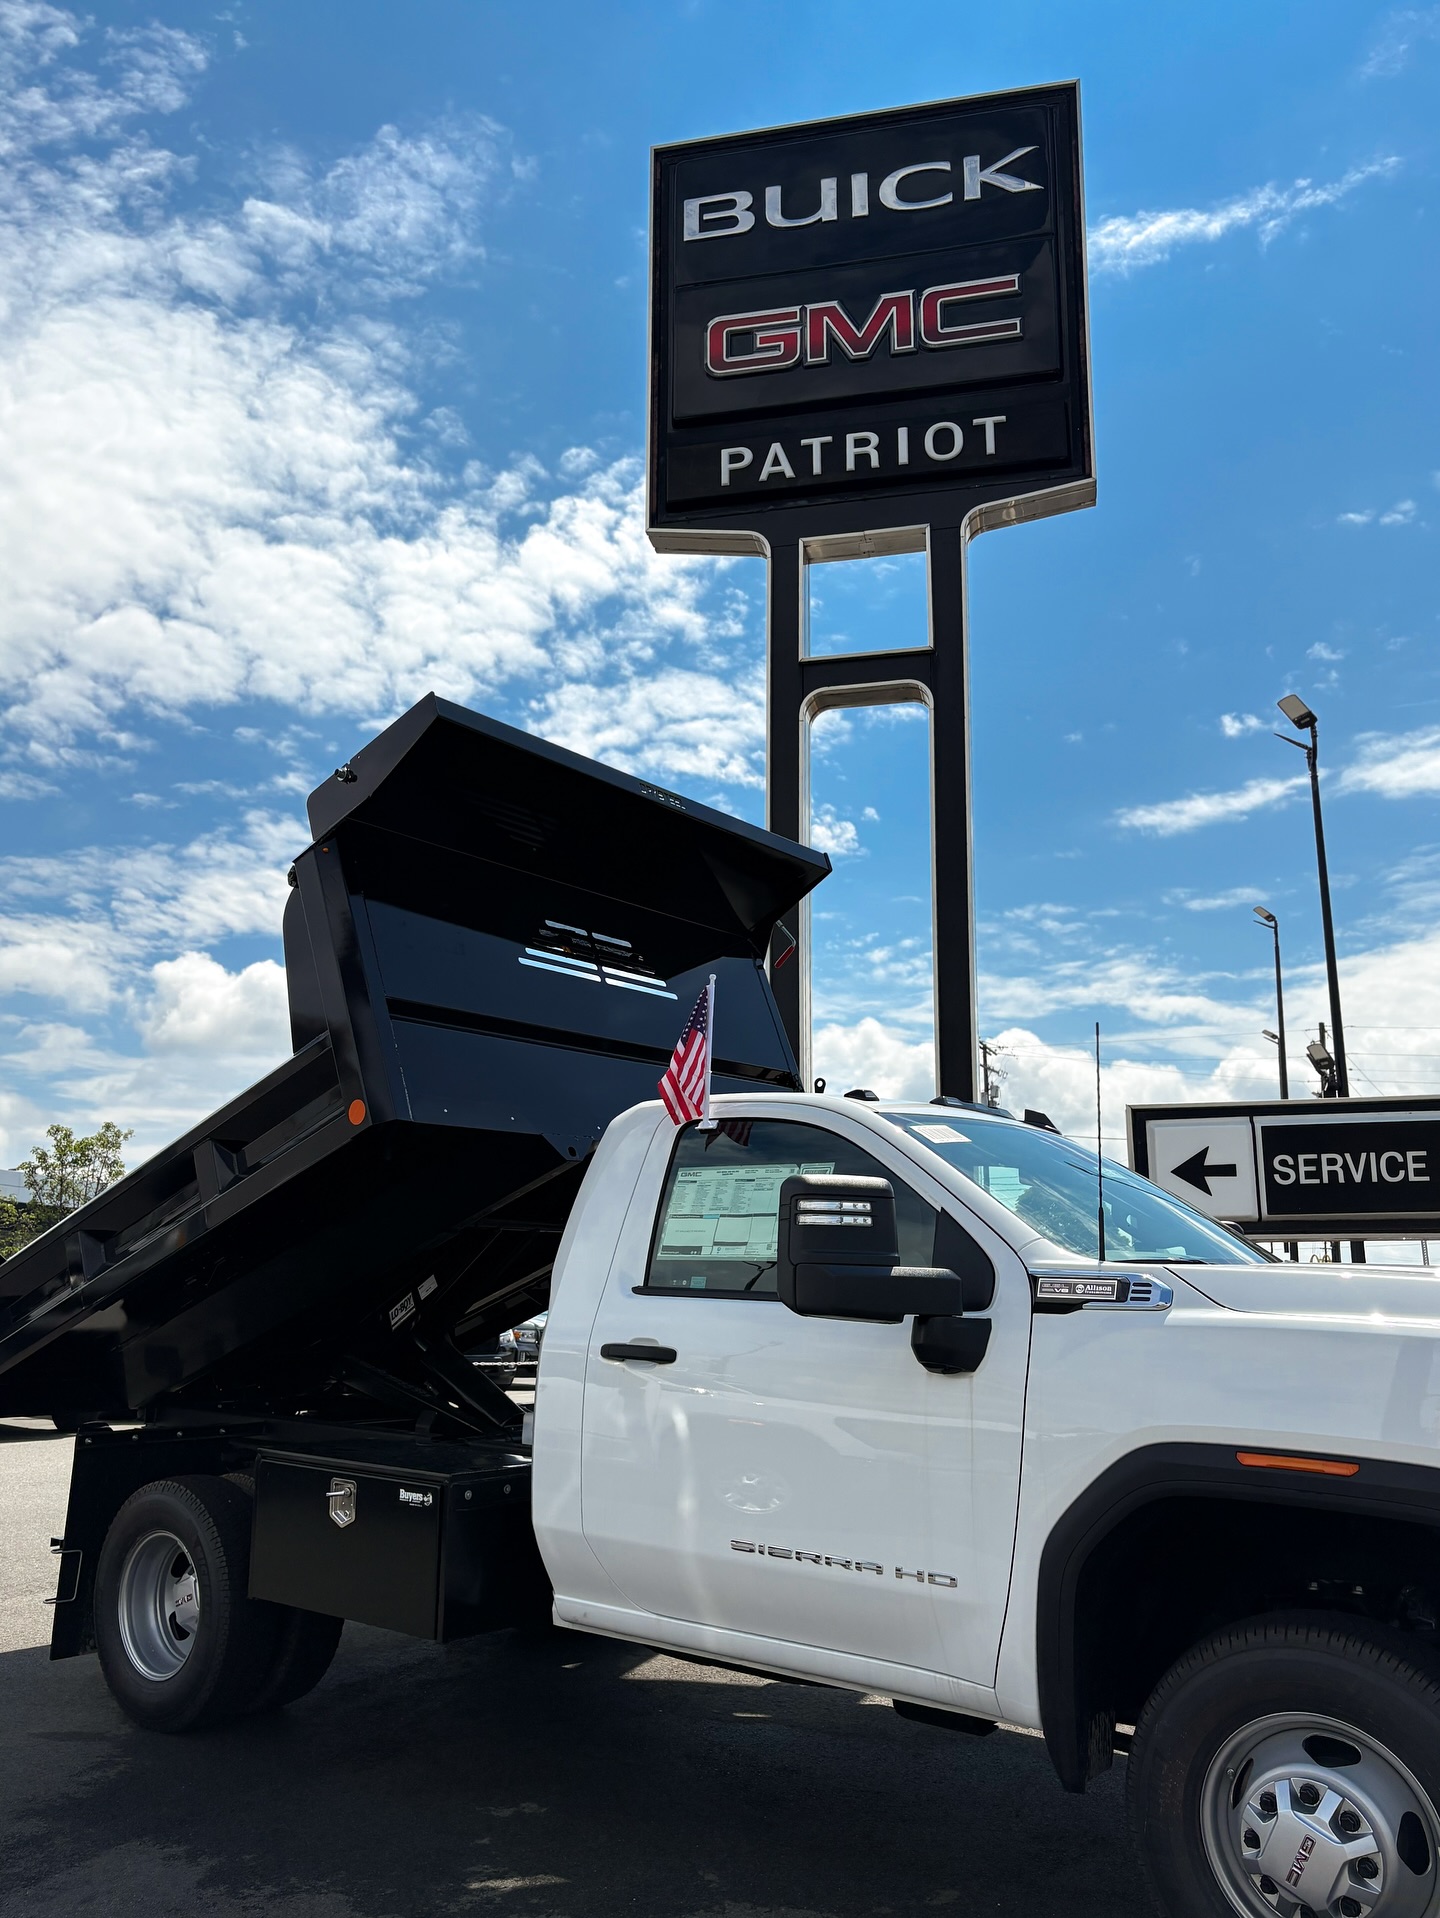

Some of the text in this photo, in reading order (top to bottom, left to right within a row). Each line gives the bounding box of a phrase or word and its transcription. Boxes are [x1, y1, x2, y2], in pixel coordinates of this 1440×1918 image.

[684, 145, 1044, 242] BUICK
[705, 273, 1023, 379] GMC
[721, 415, 1007, 487] PATRIOT
[1272, 1150, 1431, 1186] SERVICE
[399, 1488, 424, 1502] Buyers
[730, 1538, 958, 1588] SIERRA HD
[1285, 1834, 1317, 1889] GMC
